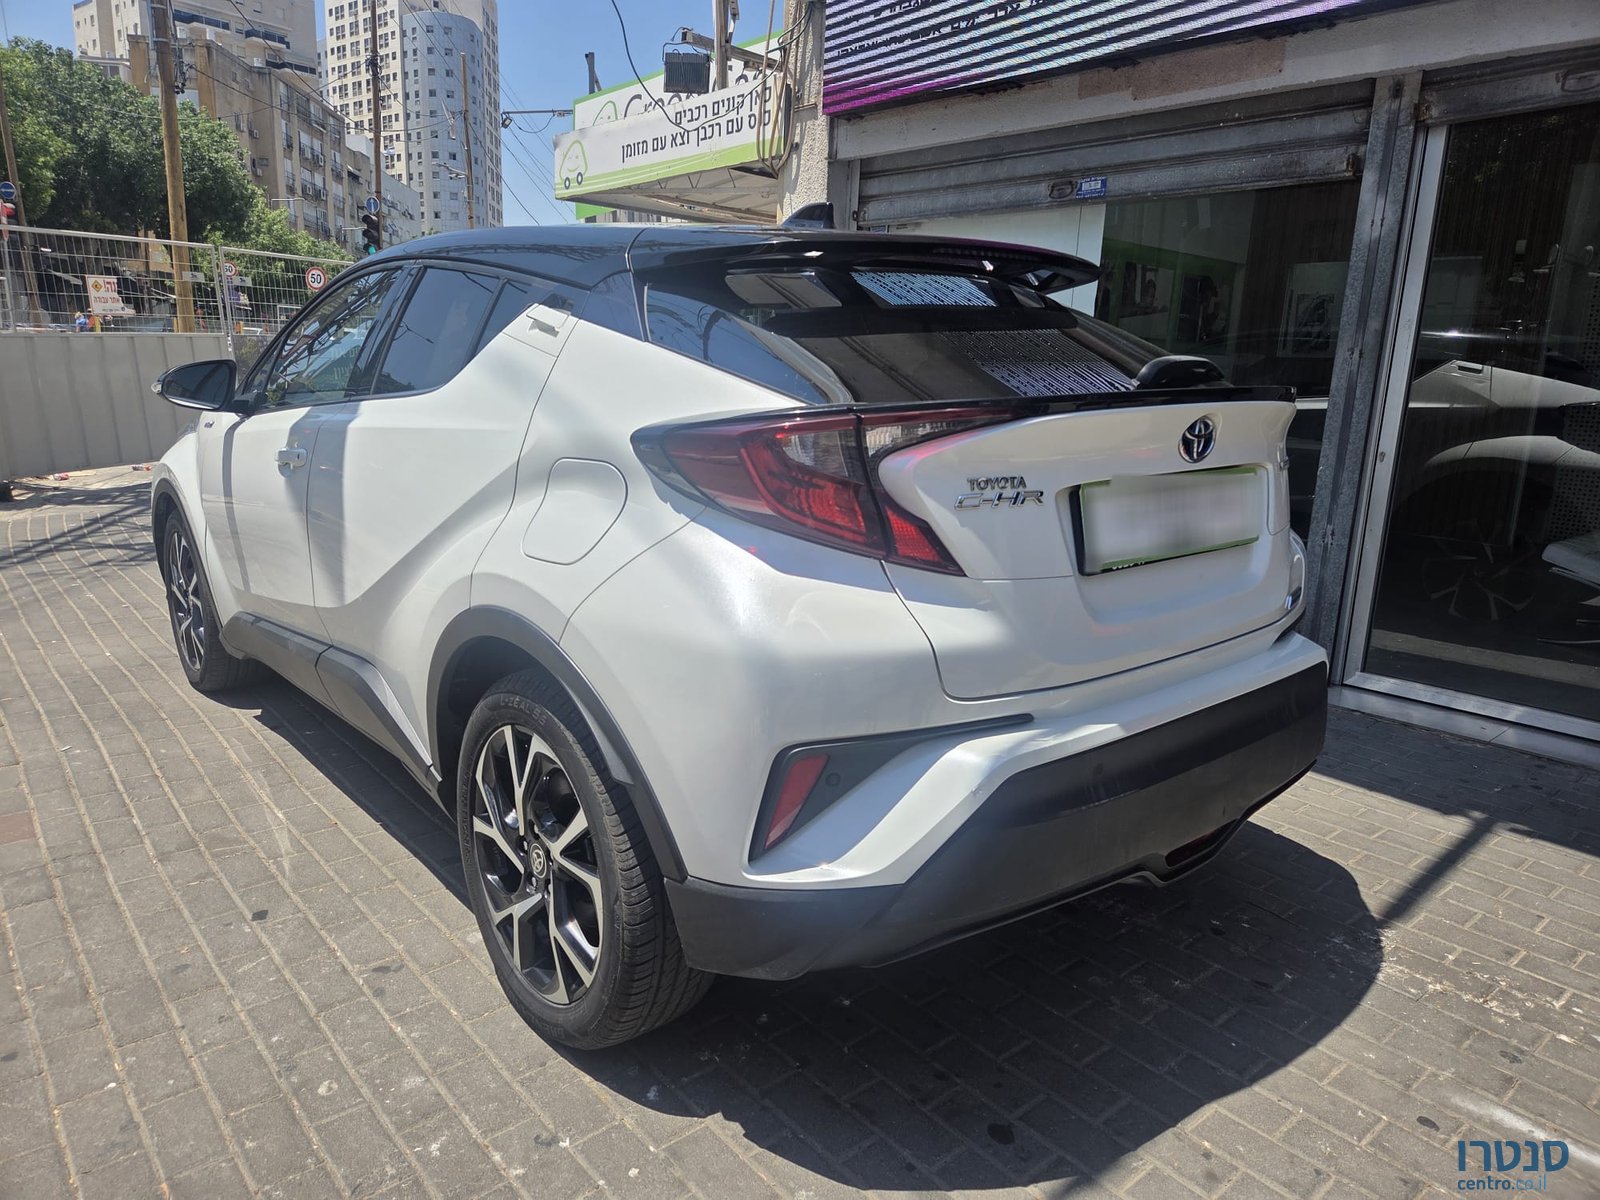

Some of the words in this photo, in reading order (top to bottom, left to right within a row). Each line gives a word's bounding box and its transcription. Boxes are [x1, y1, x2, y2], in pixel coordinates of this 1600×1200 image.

[674, 104, 708, 125] רכבים
[712, 93, 745, 117] קונים
[726, 116, 743, 135] עם
[748, 110, 771, 130] כס
[652, 135, 667, 152] עם
[670, 130, 690, 148] וצא
[696, 122, 722, 147] רכבך
[621, 140, 648, 163] מזומן
[310, 273, 322, 284] 50
[967, 476, 1027, 491] TOYOTA
[955, 491, 1045, 511] C-HR
